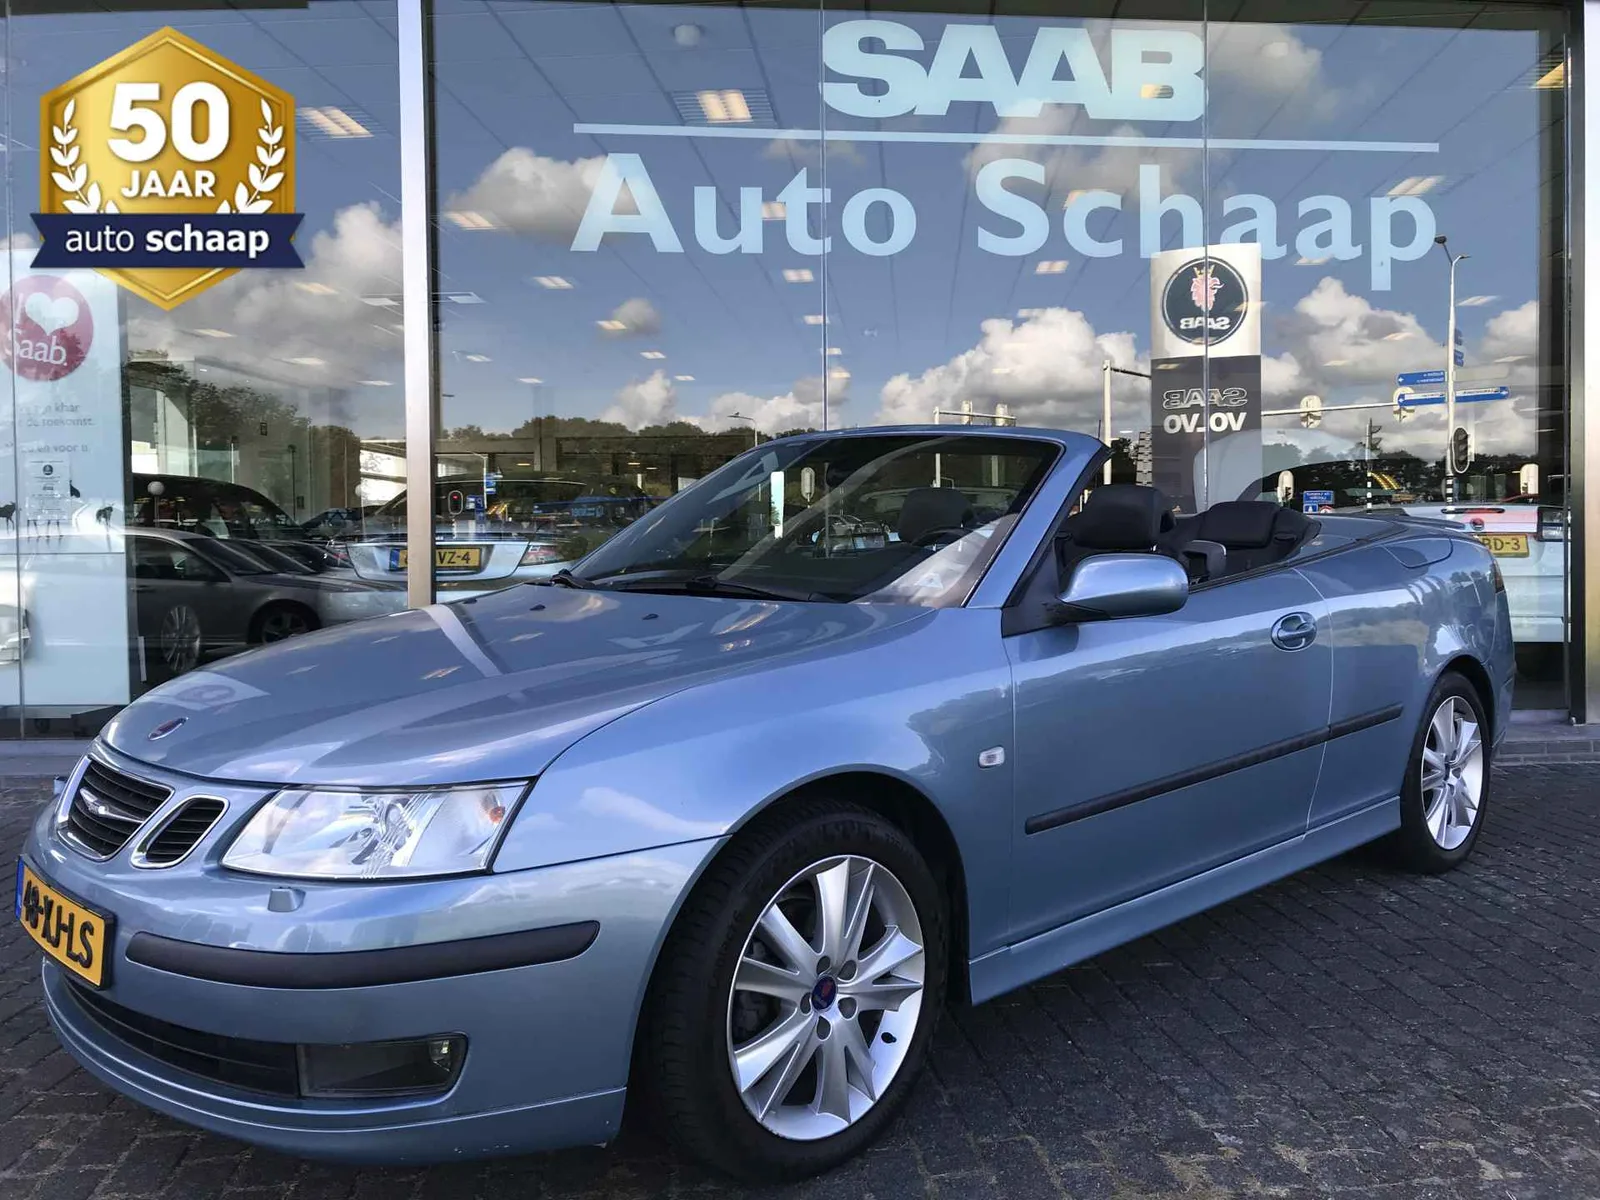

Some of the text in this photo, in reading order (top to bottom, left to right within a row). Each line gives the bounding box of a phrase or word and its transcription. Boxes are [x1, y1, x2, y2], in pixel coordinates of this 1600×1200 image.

[822, 20, 1204, 121] SAAB
[570, 152, 1437, 291] Auto Schaap
